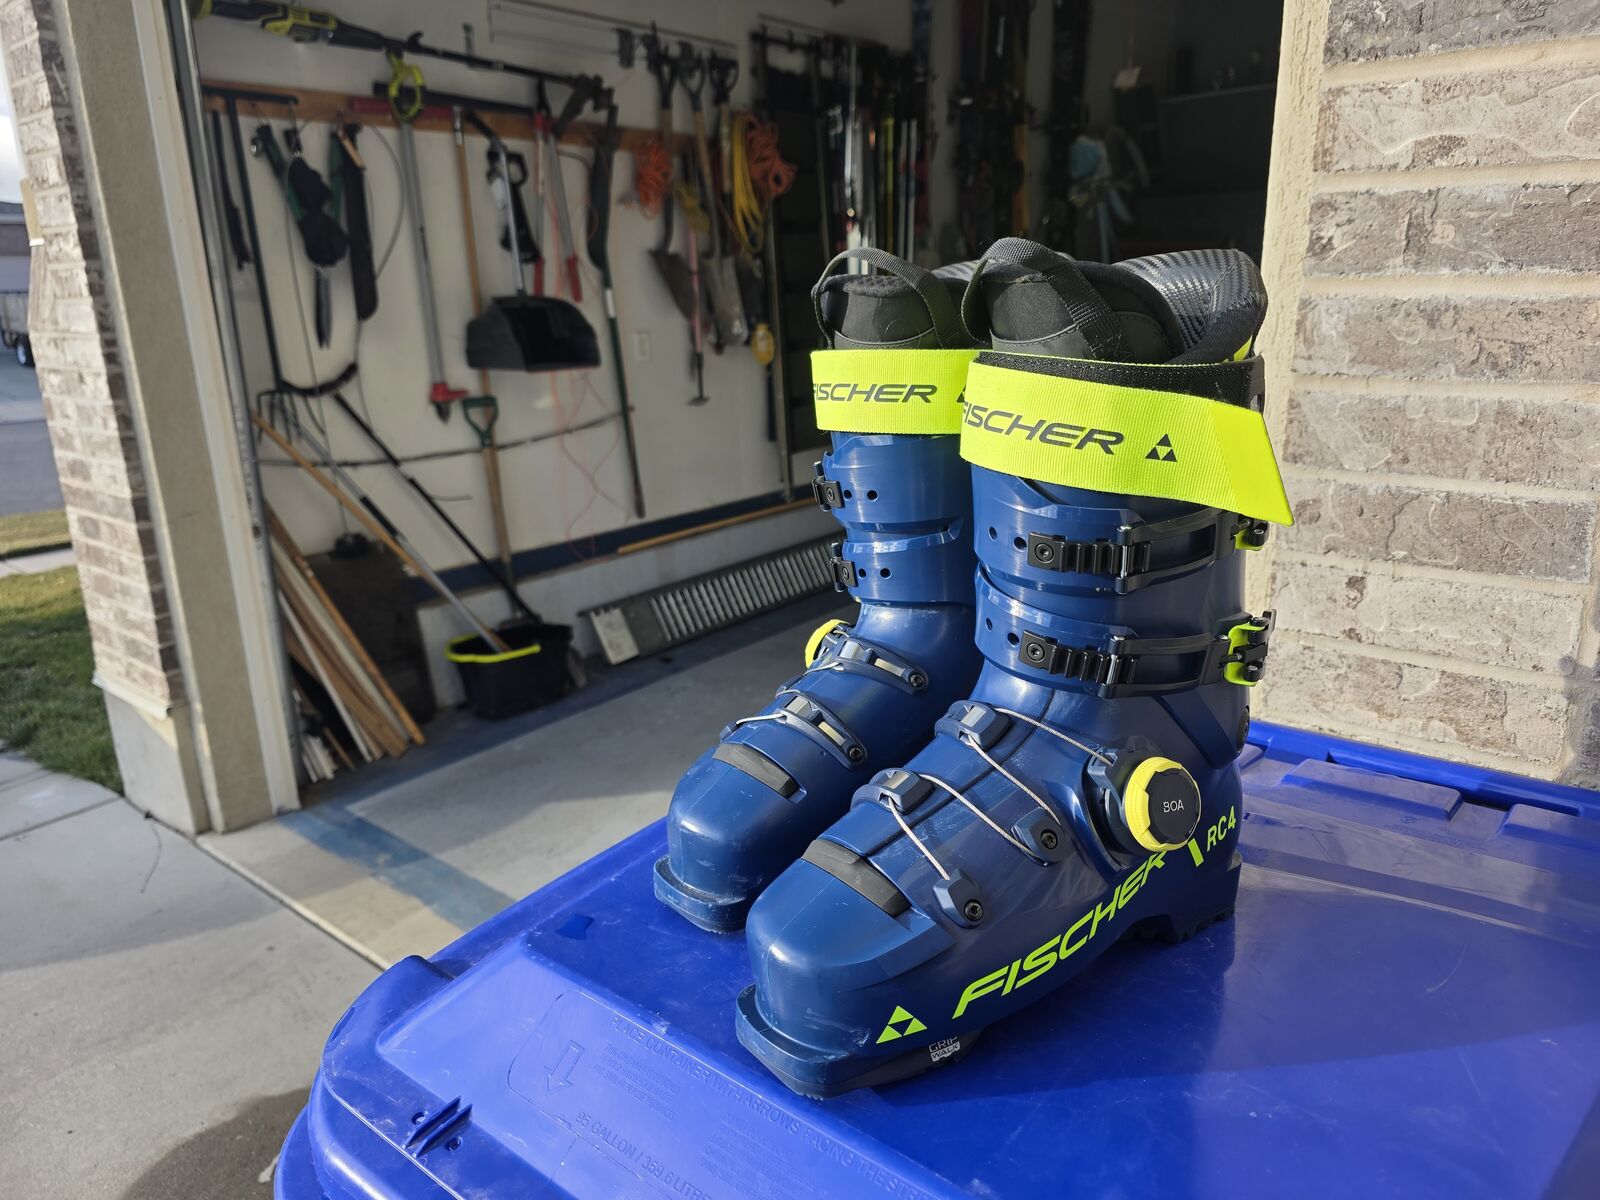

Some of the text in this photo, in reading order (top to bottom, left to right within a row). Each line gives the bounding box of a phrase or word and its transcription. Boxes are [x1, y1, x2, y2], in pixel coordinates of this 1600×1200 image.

[1162, 799, 1185, 814] BOA
[1206, 805, 1237, 852] RC4
[951, 850, 1167, 1020] FISCHER
[931, 1041, 960, 1060] WALK
[610, 1016, 646, 1045] PLACE
[644, 1037, 710, 1084] CONTAINER
[709, 1072, 744, 1104] WITH
[744, 1094, 801, 1135] ARROWS
[801, 1127, 855, 1167] FACING
[856, 1158, 888, 1187] THE
[575, 1111, 592, 1128] 95
[591, 1121, 638, 1159] GALLON
